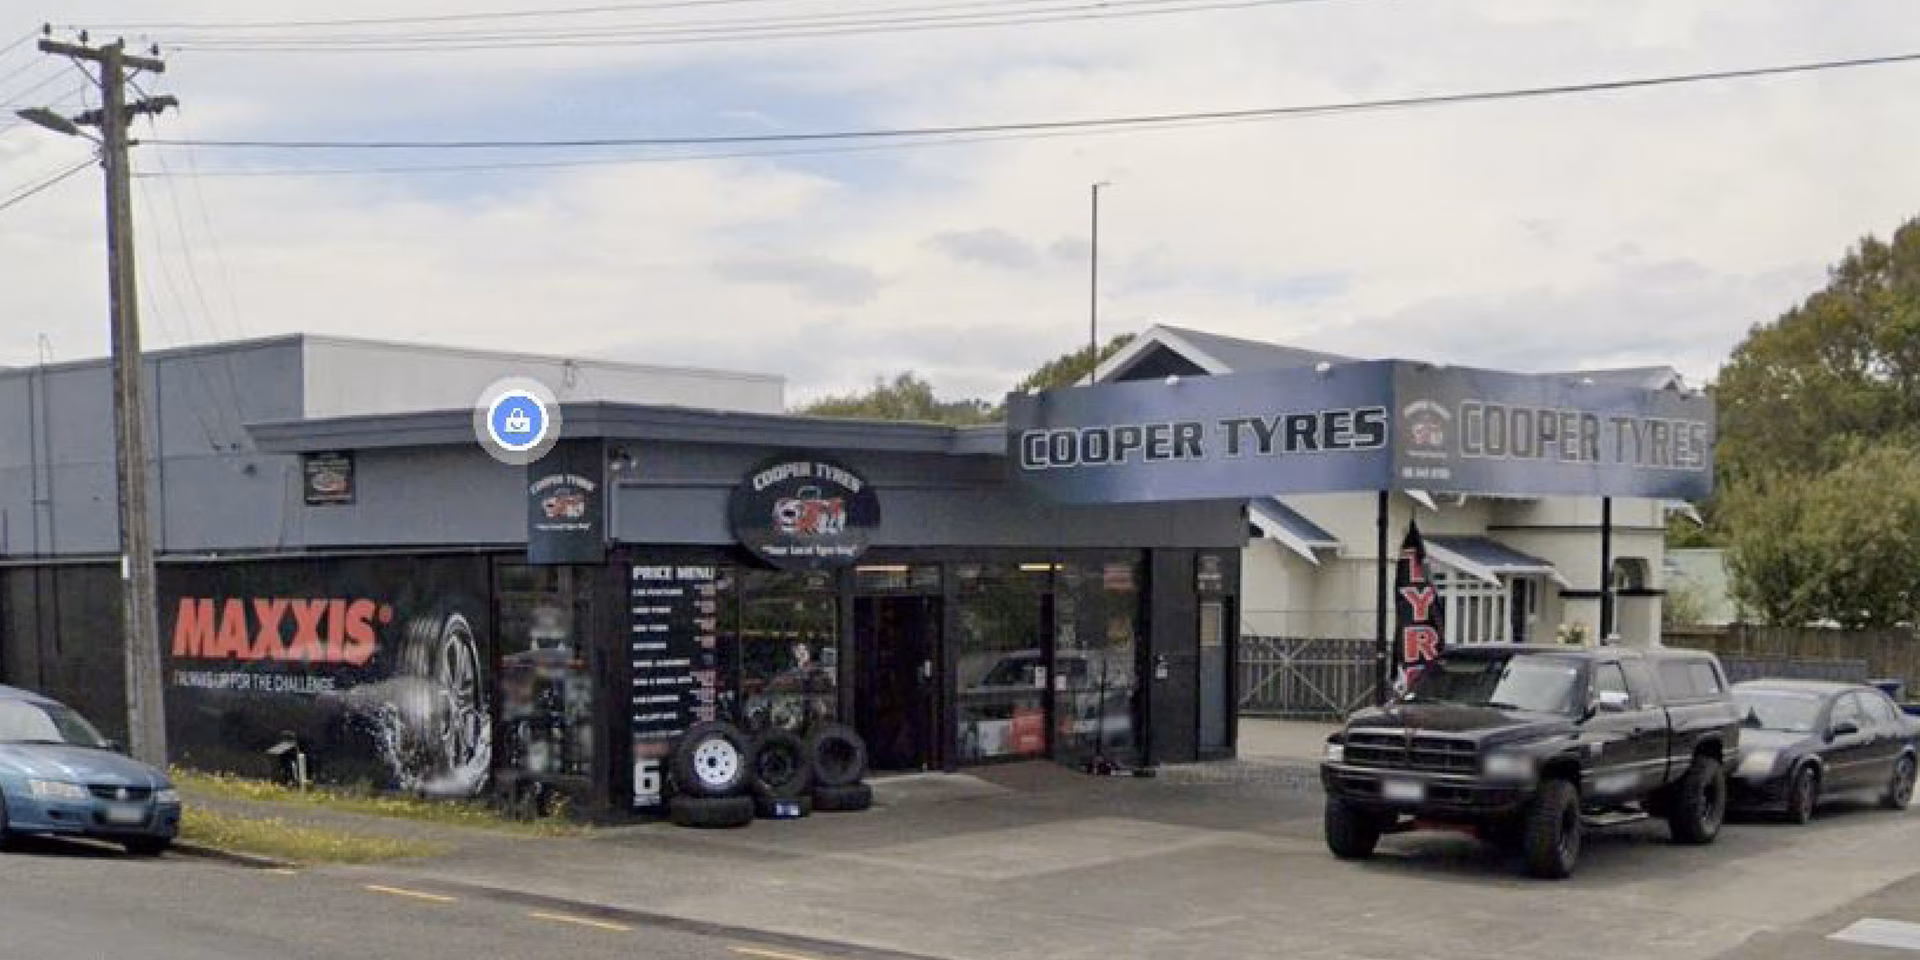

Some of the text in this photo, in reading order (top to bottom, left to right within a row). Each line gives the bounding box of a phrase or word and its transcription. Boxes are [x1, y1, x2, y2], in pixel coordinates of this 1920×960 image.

[1021, 406, 1387, 469] COOPER TYRES
[1459, 399, 1706, 470] COOPER TYRES
[753, 461, 861, 493] COOPER TYRES
[677, 565, 716, 580] MENU
[172, 597, 378, 666] MAXXIS
[254, 673, 272, 691] THE
[274, 674, 336, 693] CHALLENGE
[634, 759, 660, 795] 6
